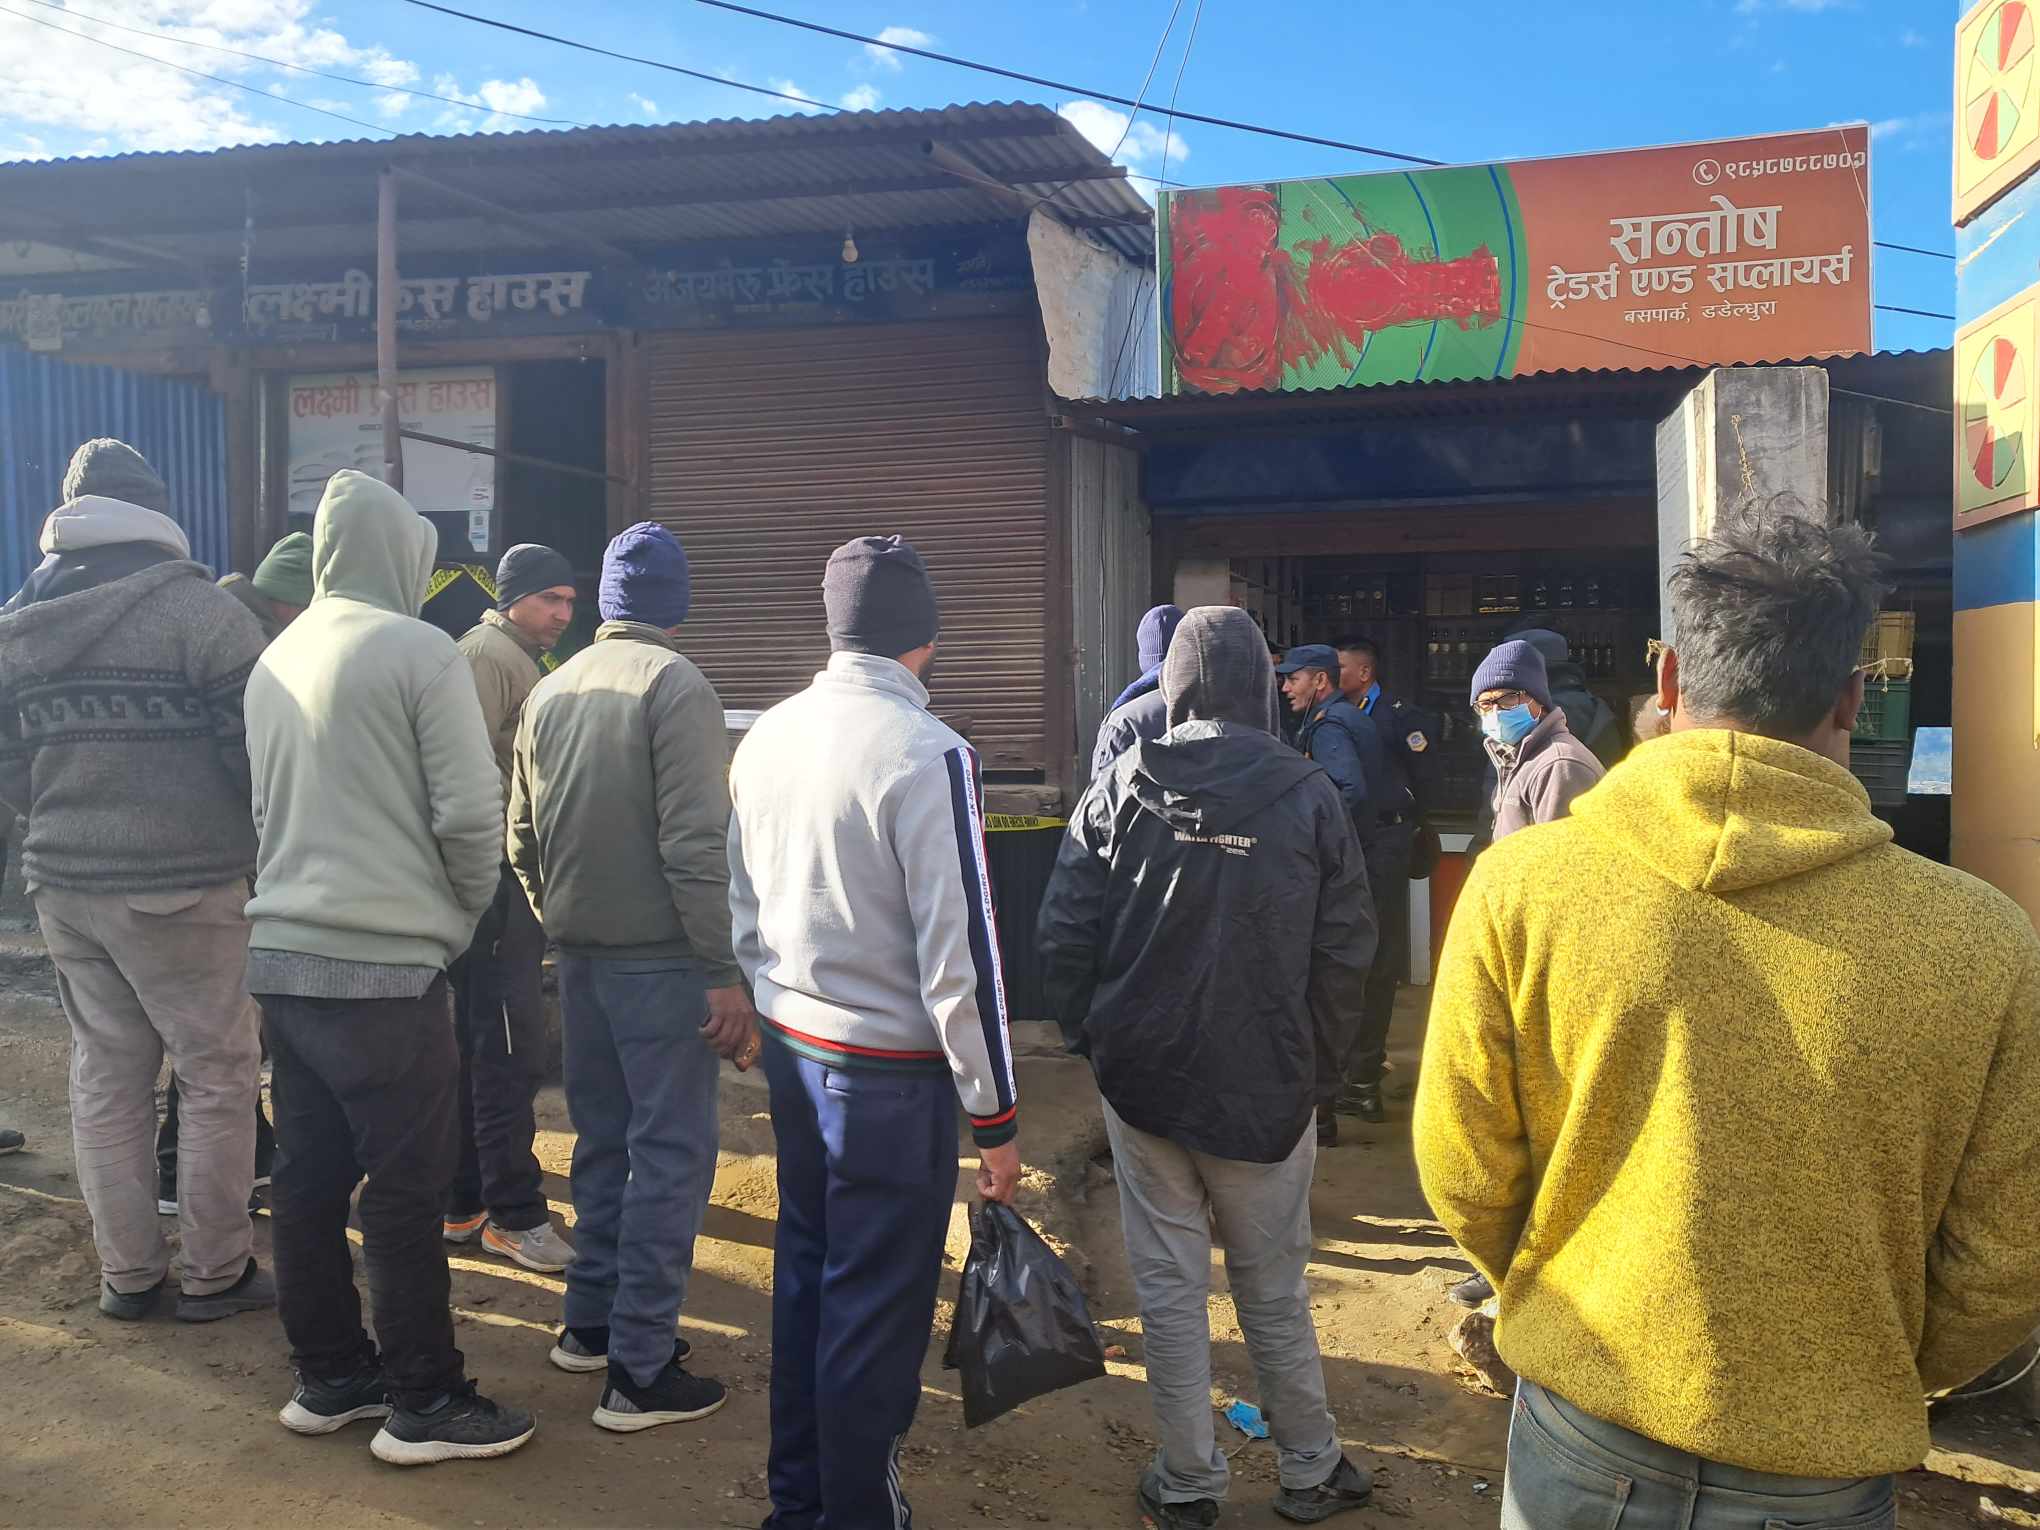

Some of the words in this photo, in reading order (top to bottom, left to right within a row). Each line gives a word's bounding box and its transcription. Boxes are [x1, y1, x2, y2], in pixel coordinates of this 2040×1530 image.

[1610, 194, 1783, 265] सन्तोष
[248, 268, 372, 325] लक्ष्मी
[467, 271, 593, 322] हाउस
[1546, 262, 1622, 310] ट्रेडर्स
[1630, 264, 1698, 297] एण्ड
[1706, 244, 1854, 293] सप्लायर्स
[1624, 302, 1691, 324] बसपार्क,
[1701, 299, 1779, 321] डडेल्धुरा
[293, 376, 360, 418] लक्ष्मी
[428, 378, 493, 414] हाउस
